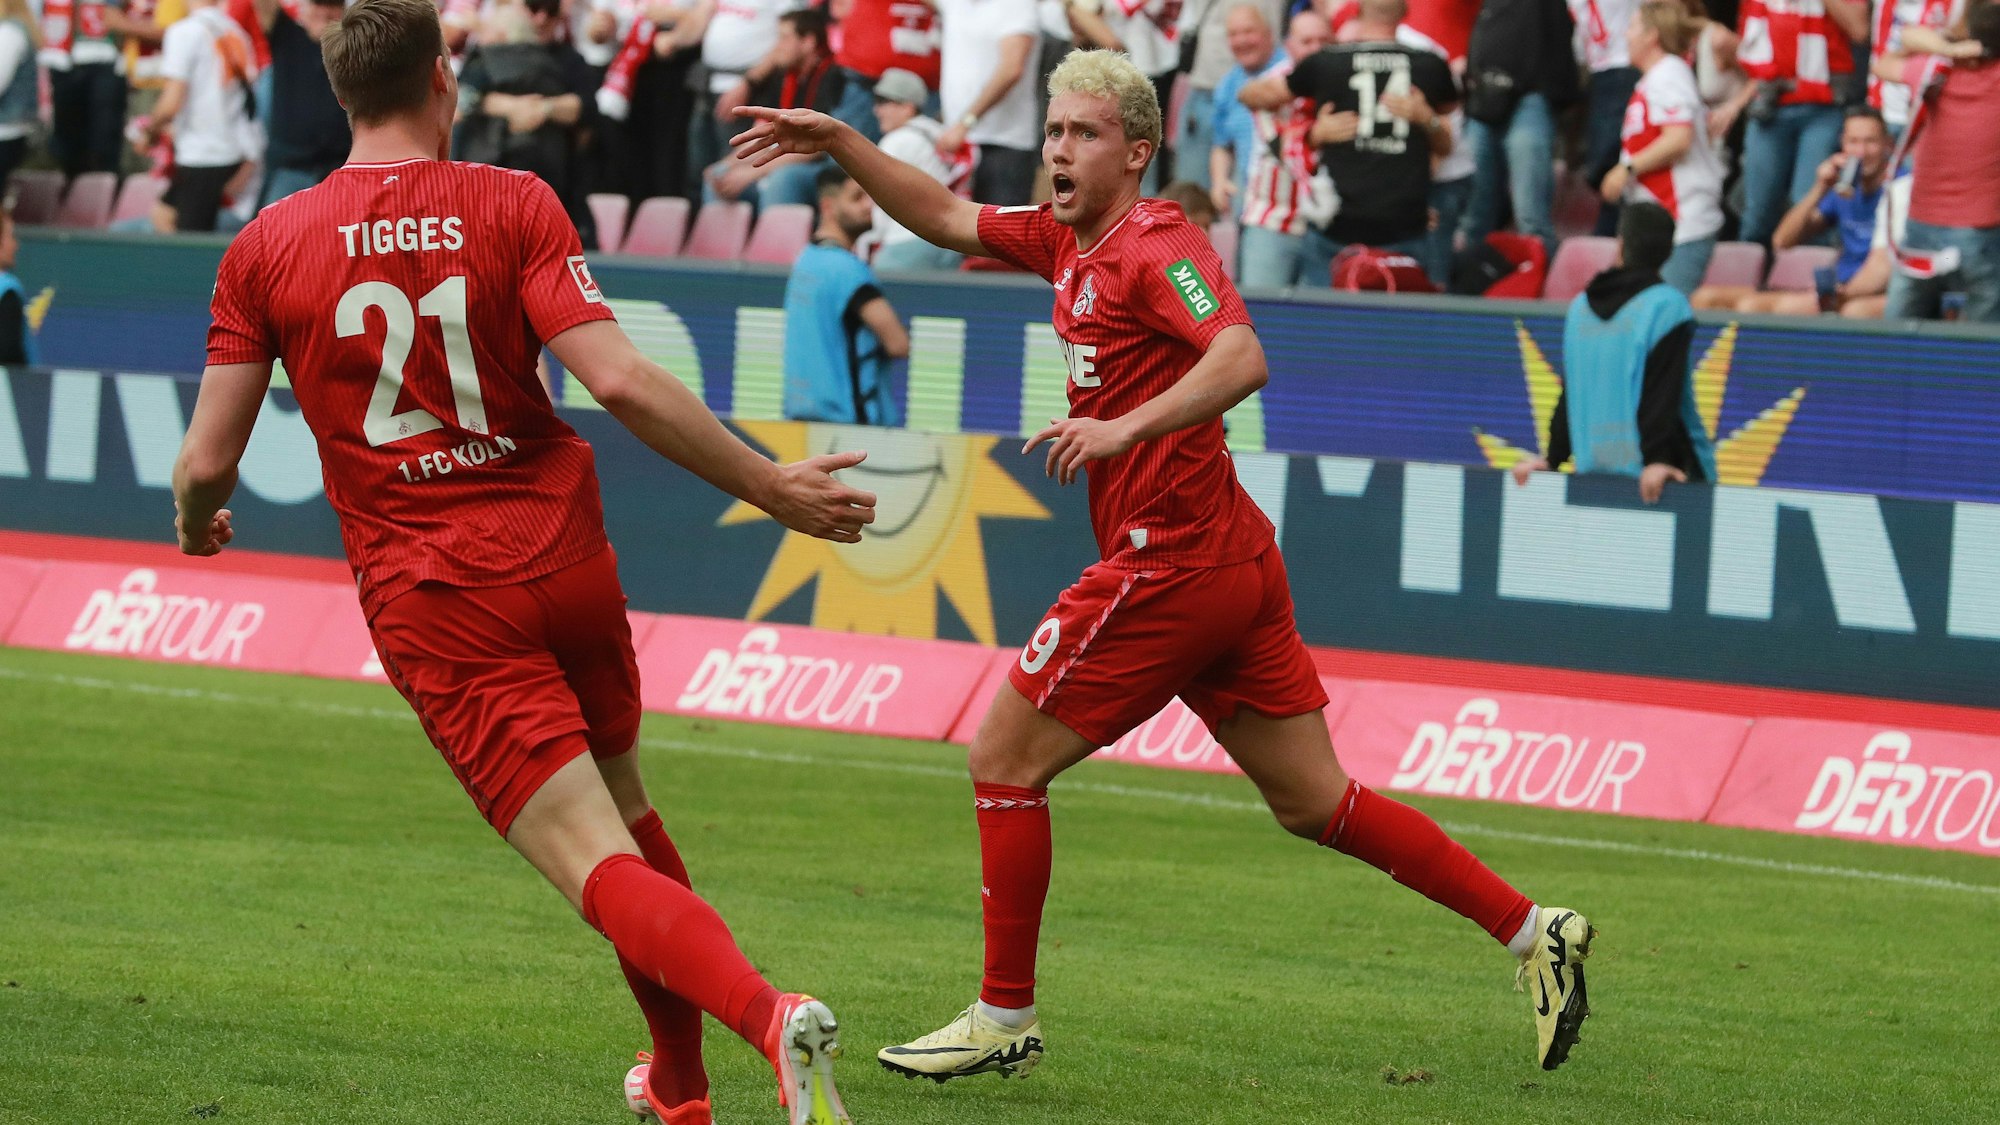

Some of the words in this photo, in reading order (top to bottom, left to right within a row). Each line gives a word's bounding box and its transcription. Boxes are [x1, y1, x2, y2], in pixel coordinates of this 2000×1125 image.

[1348, 70, 1412, 139] 14
[338, 216, 464, 257] TIGGES
[1173, 265, 1212, 315] DEVK
[335, 276, 489, 447] 21
[451, 435, 516, 467] KÖLN
[63, 588, 265, 663] DERTOUR
[1019, 617, 1060, 674] 9
[675, 647, 903, 728] DERTOUR
[1389, 720, 1647, 813] DERTOUR
